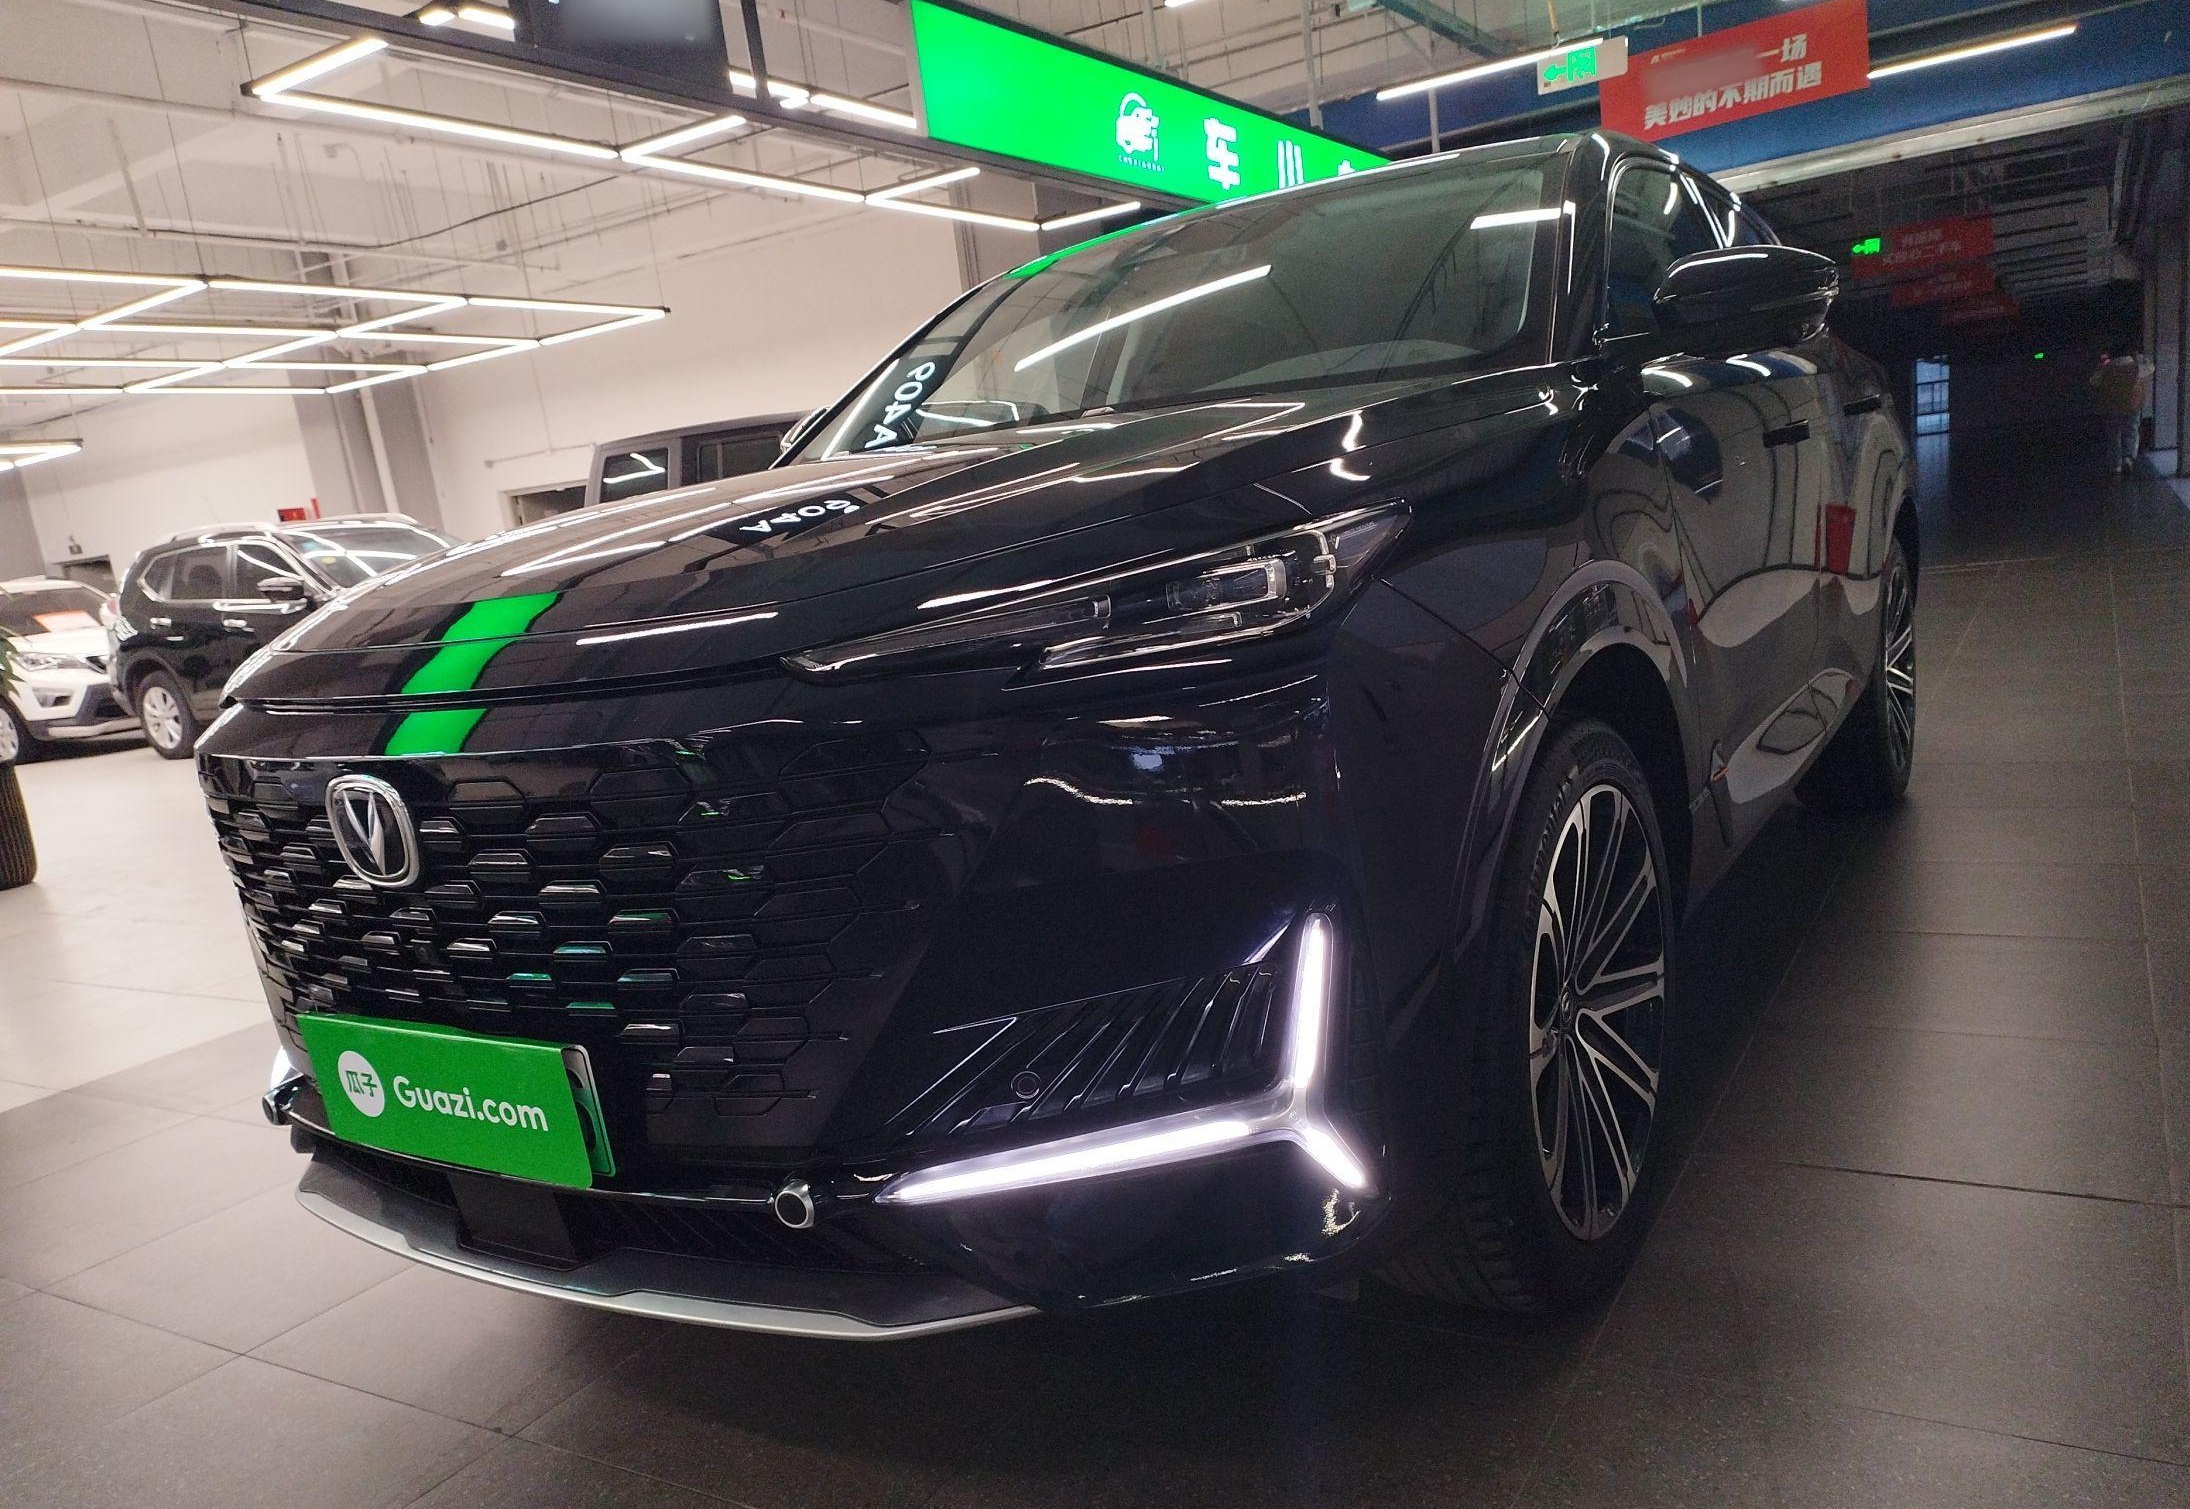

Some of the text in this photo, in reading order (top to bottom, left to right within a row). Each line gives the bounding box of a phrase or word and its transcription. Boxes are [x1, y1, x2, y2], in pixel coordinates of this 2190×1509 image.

[1644, 61, 1823, 130] 美妙的不期而遇
[345, 1070, 377, 1097] 瓜子
[393, 1075, 549, 1132] Guazi.com
